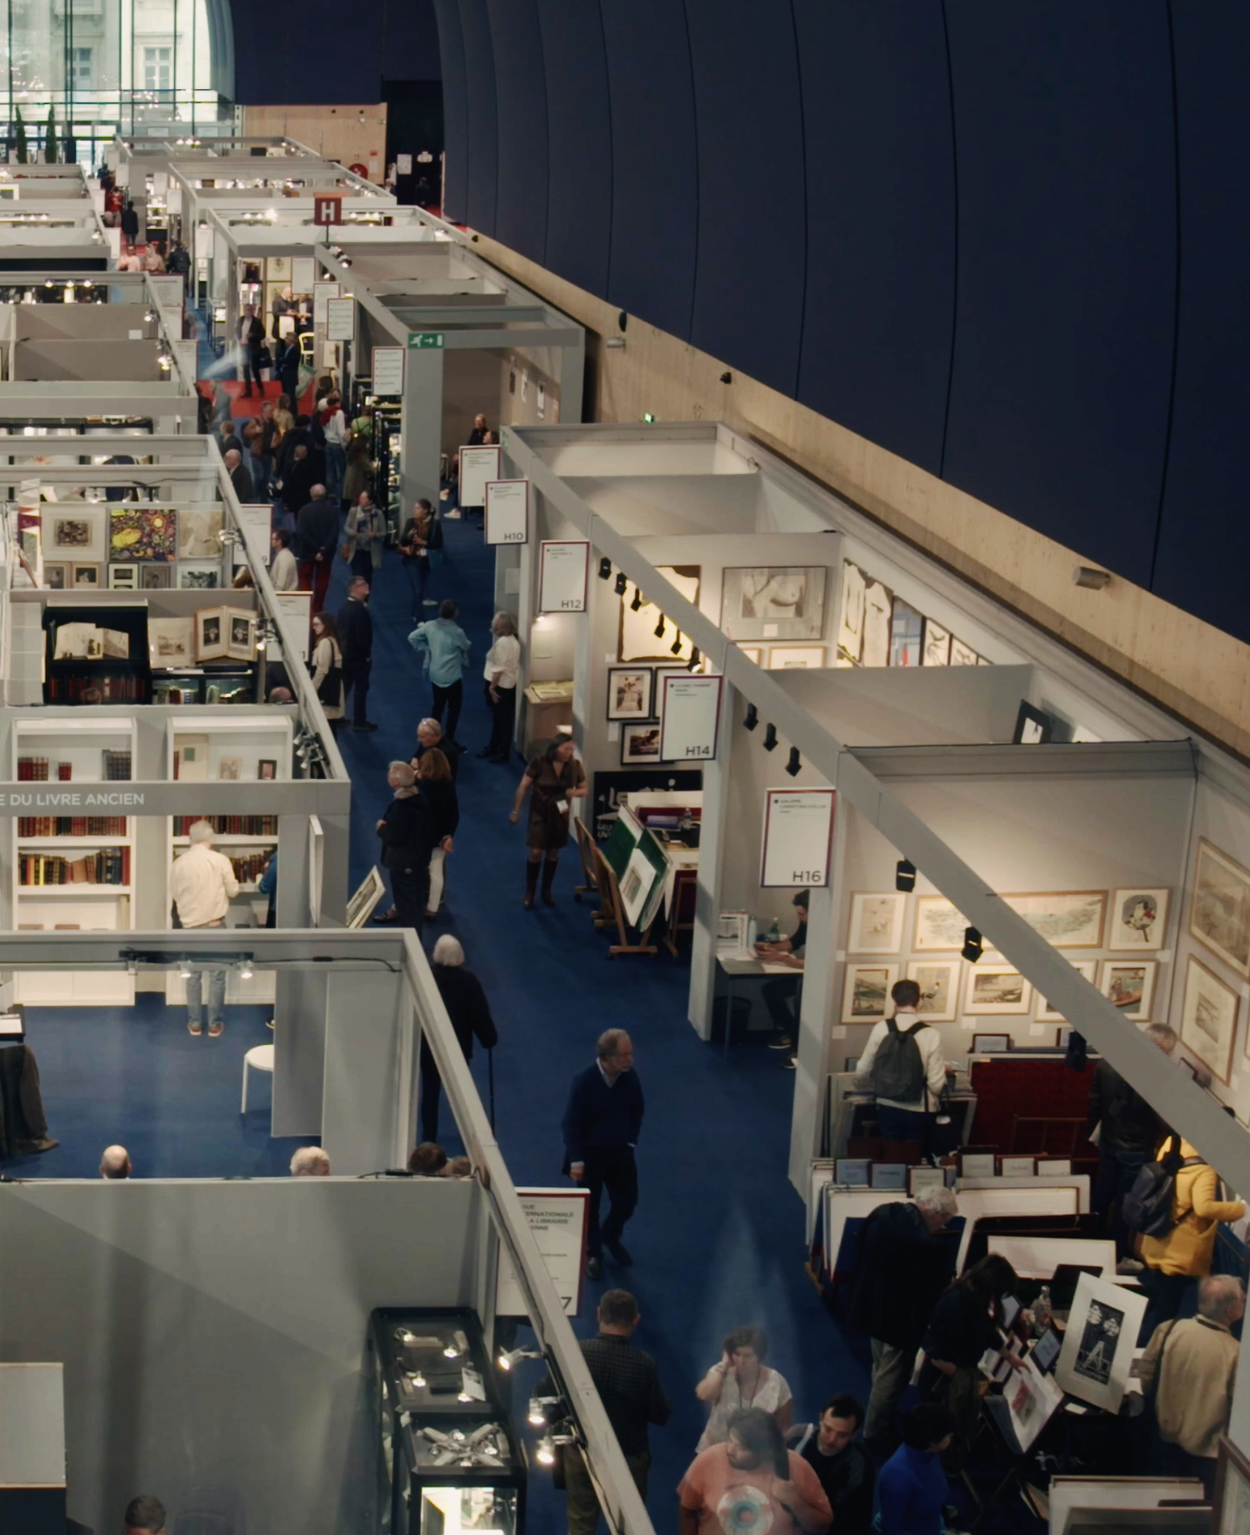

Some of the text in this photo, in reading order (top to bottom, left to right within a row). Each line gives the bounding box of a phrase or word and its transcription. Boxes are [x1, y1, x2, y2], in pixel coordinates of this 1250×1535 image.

[321, 202, 335, 222] H
[504, 532, 524, 541] H10
[561, 599, 582, 609] H12
[685, 745, 710, 756] H14
[9, 793, 32, 806] DU
[36, 793, 81, 806] LIVRE
[84, 793, 145, 806] ANCIEN
[792, 870, 822, 883] H16
